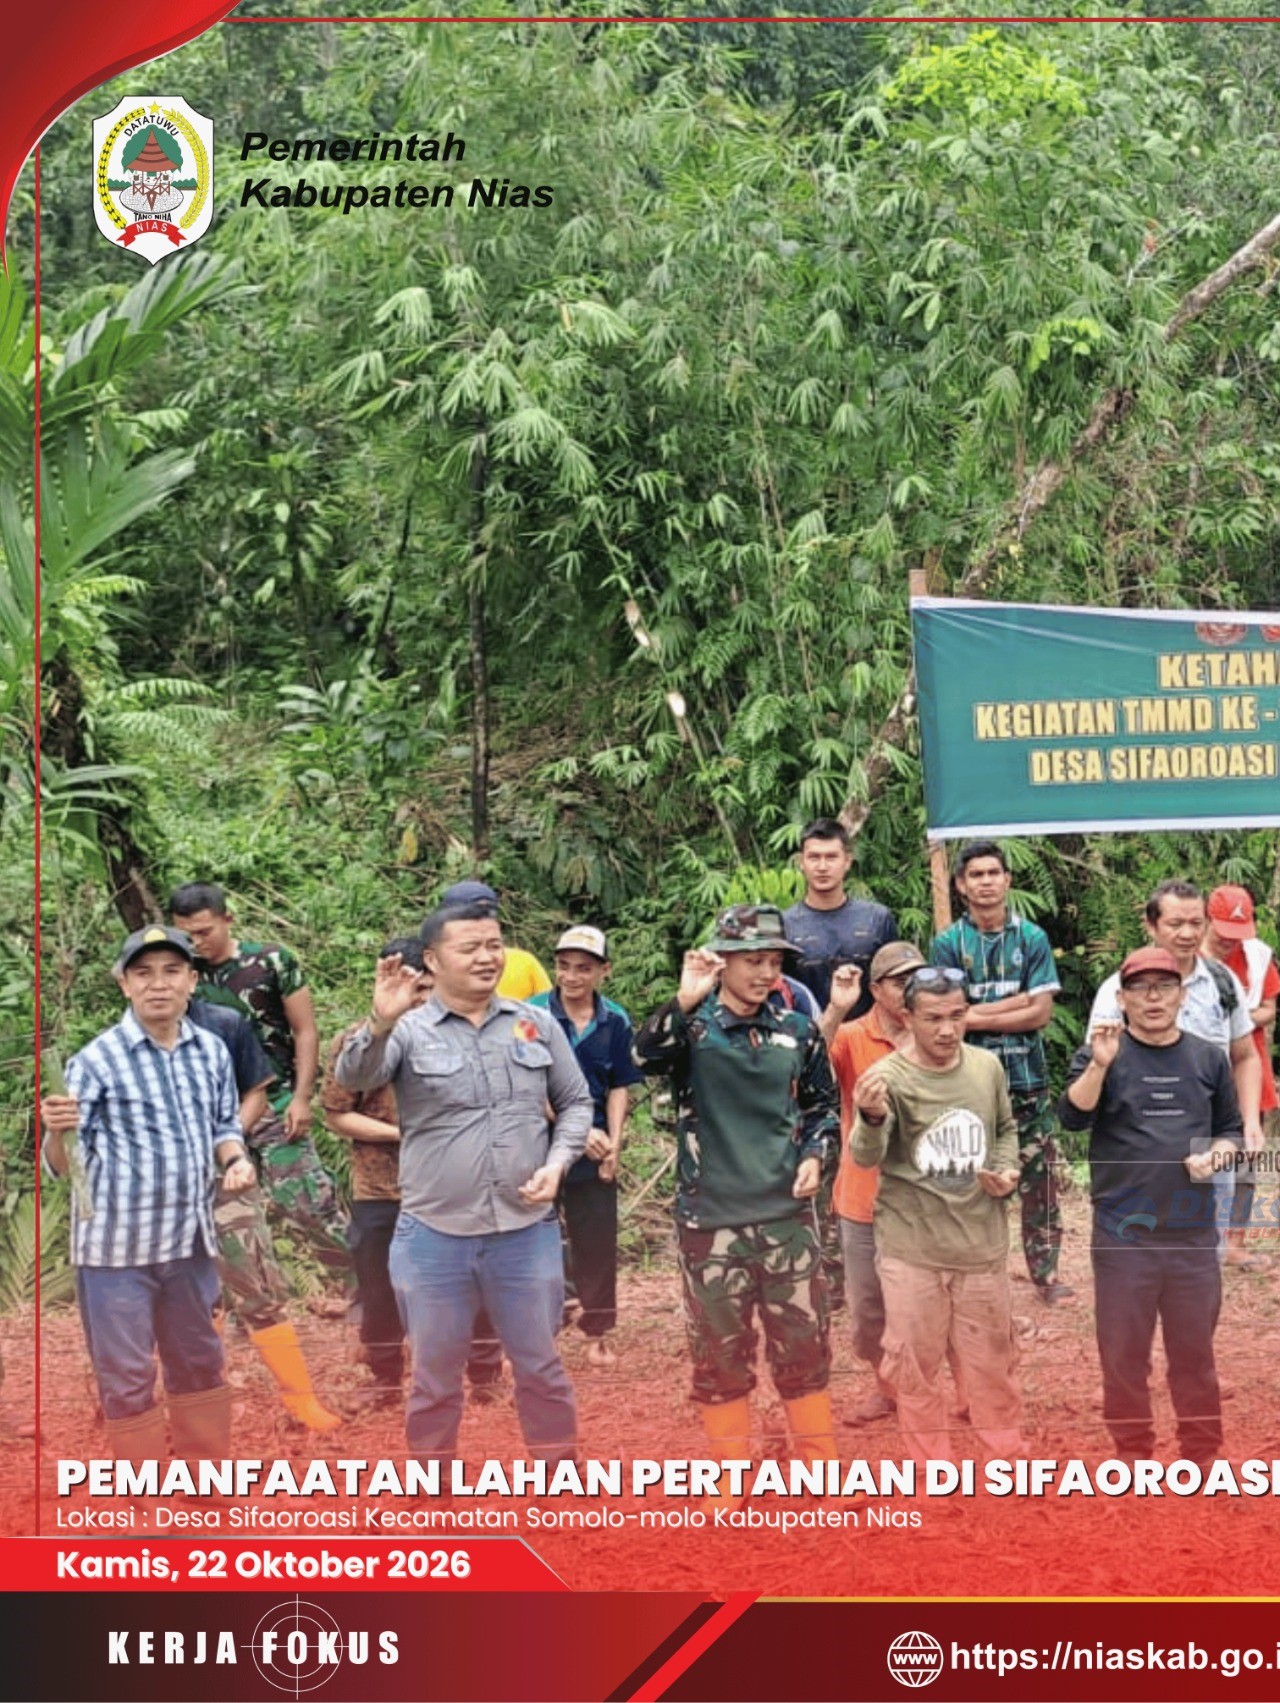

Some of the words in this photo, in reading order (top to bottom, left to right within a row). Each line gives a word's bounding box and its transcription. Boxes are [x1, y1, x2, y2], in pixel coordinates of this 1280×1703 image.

[975, 701, 1116, 739] KEGIATAN
[1123, 697, 1213, 735] TMMD
[1223, 696, 1257, 731] KE
[1031, 750, 1103, 783] DESA
[1110, 744, 1276, 780] SIFAOROASI
[927, 1123, 982, 1158] WILD
